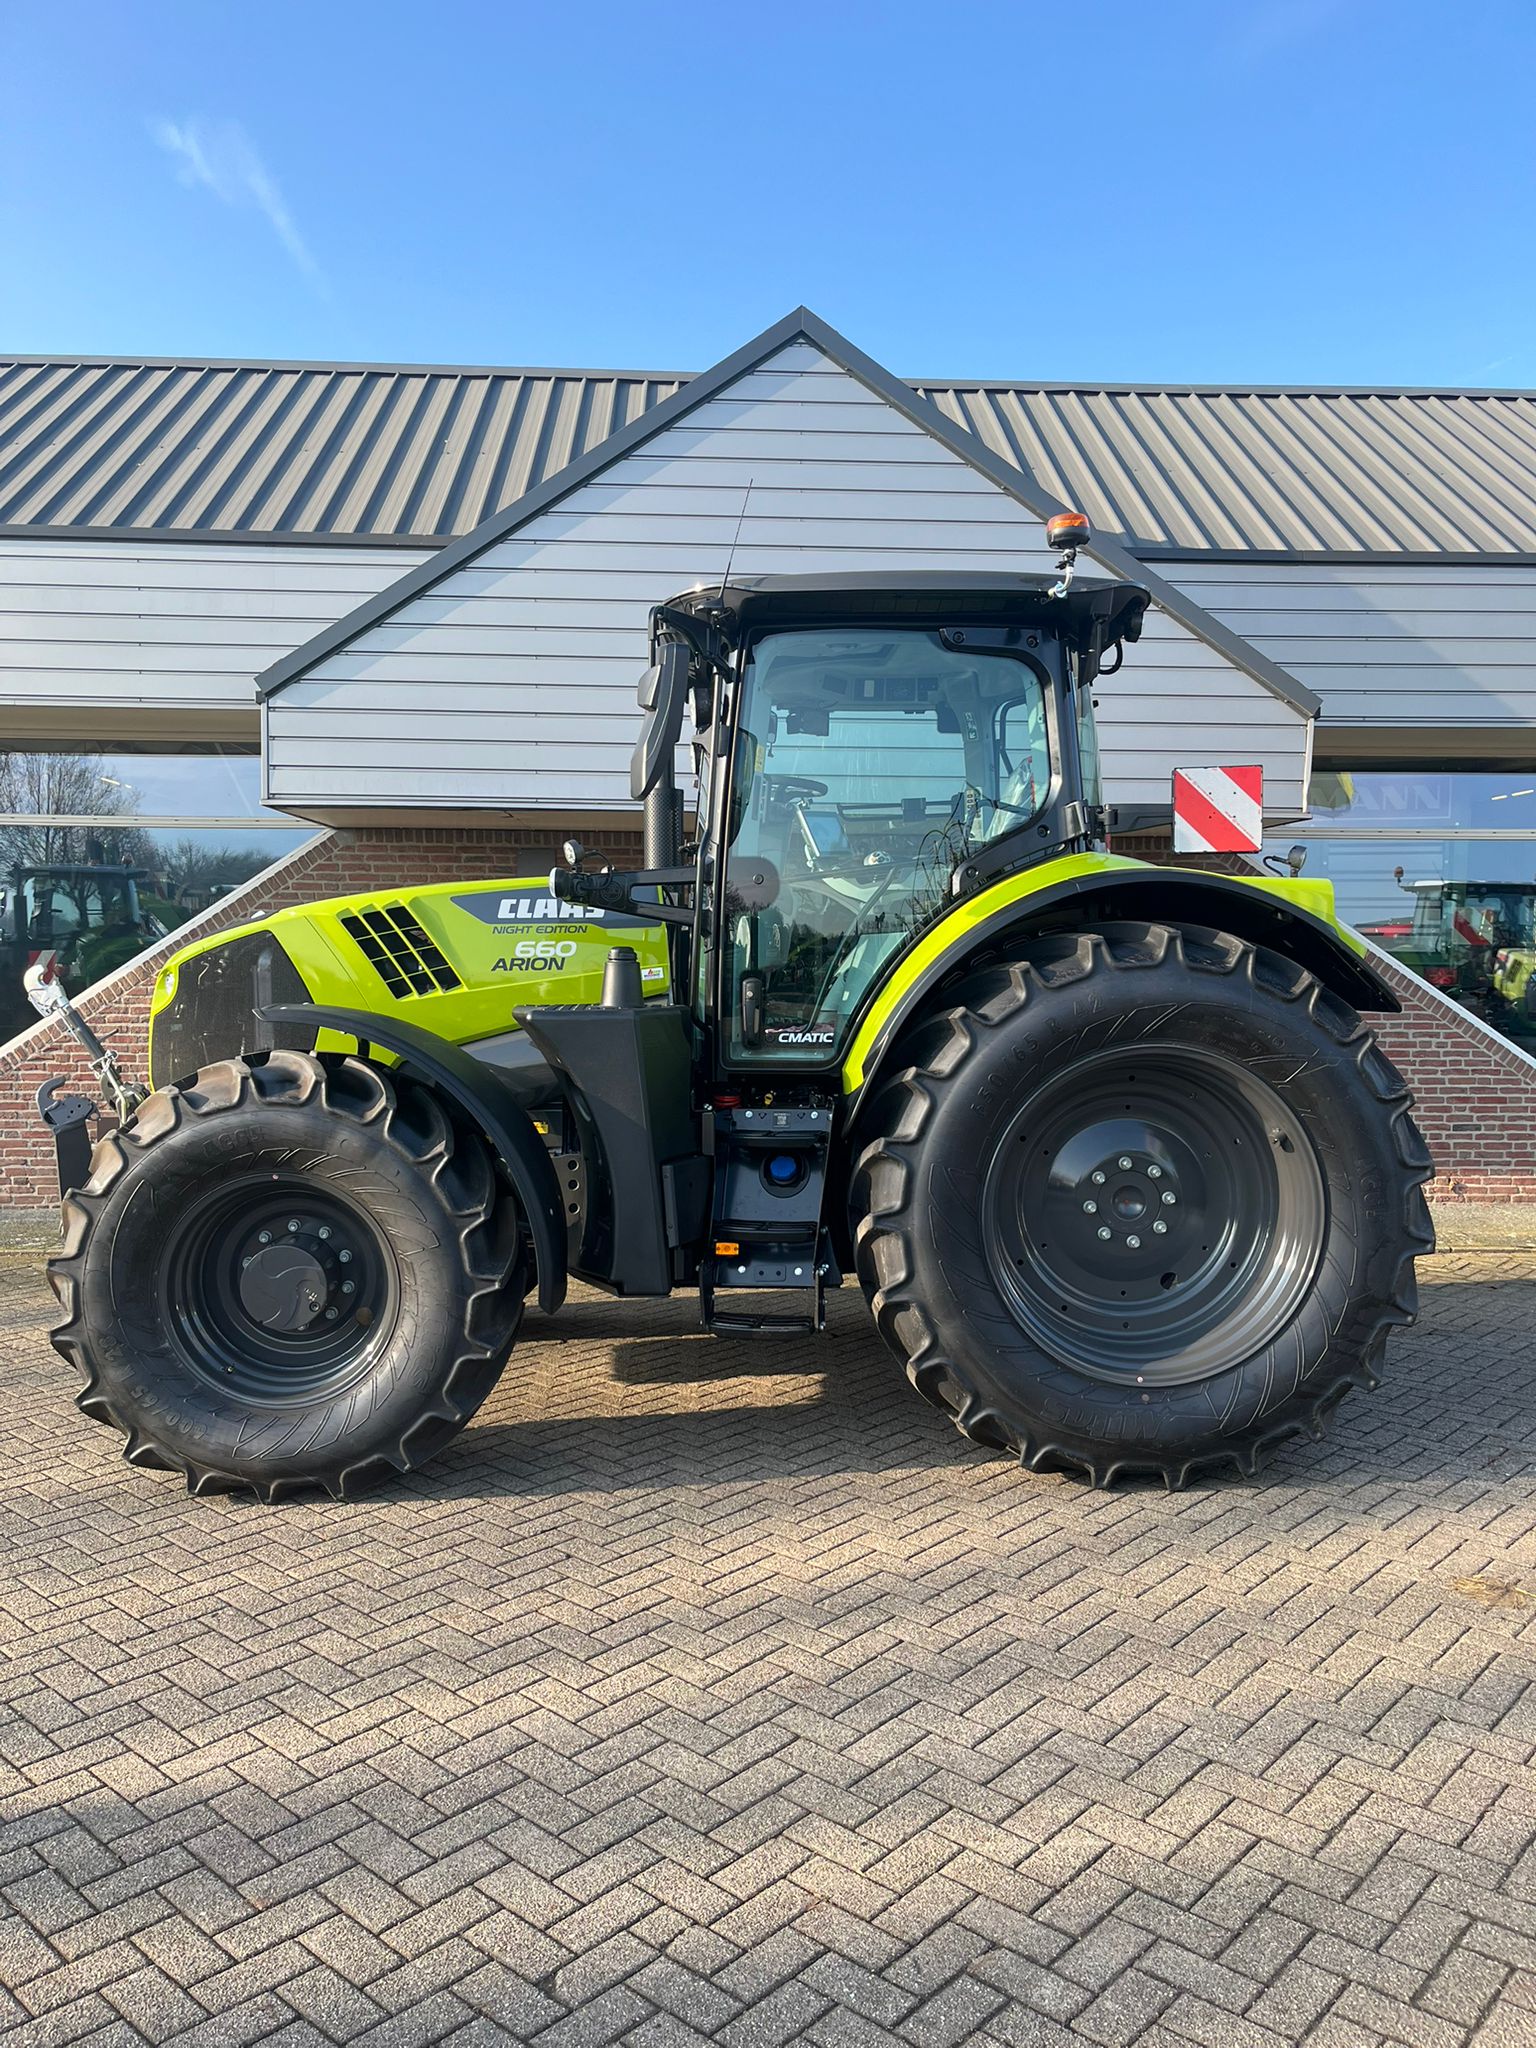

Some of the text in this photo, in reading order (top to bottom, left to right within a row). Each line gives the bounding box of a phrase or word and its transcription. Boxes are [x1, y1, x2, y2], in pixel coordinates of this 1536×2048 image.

[497, 898, 605, 919] CLAAS
[492, 925, 588, 934] NIGHT EDITION
[515, 940, 577, 958] 660
[491, 957, 565, 972] ARION
[778, 1032, 835, 1043] CMATIC
